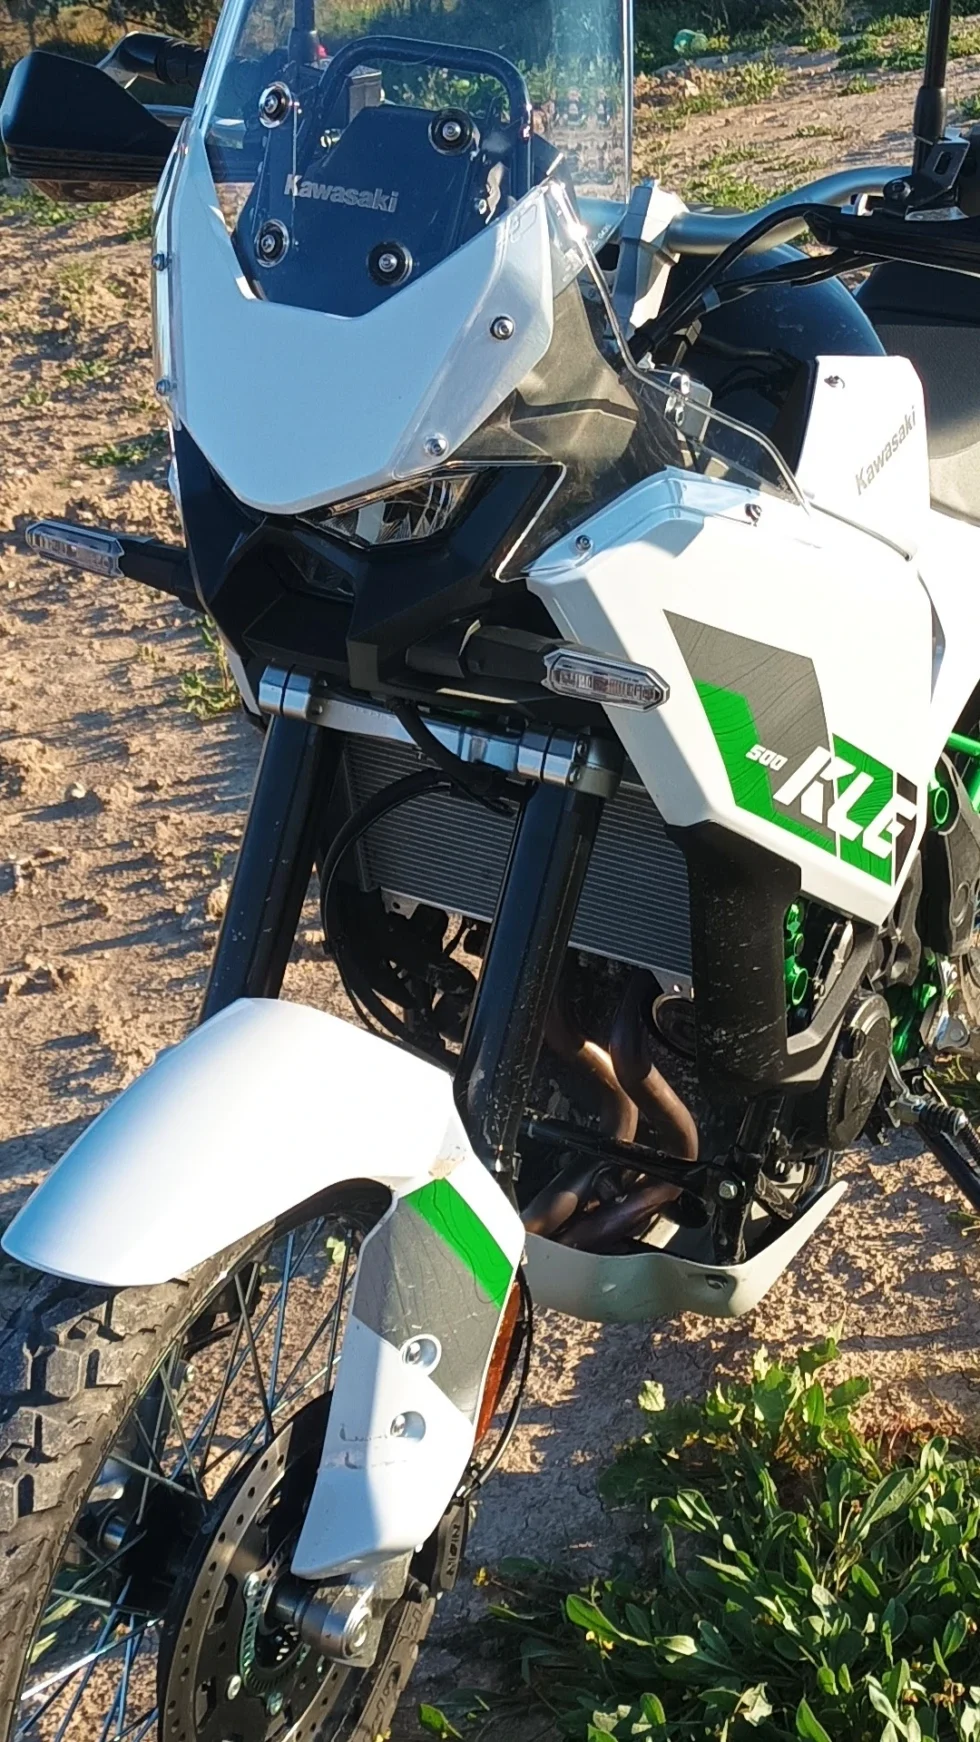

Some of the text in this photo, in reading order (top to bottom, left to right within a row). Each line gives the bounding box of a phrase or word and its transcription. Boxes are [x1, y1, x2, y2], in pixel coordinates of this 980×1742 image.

[284, 173, 399, 213] Kawasaki
[855, 404, 916, 496] Kawasaki
[745, 743, 789, 772] 500
